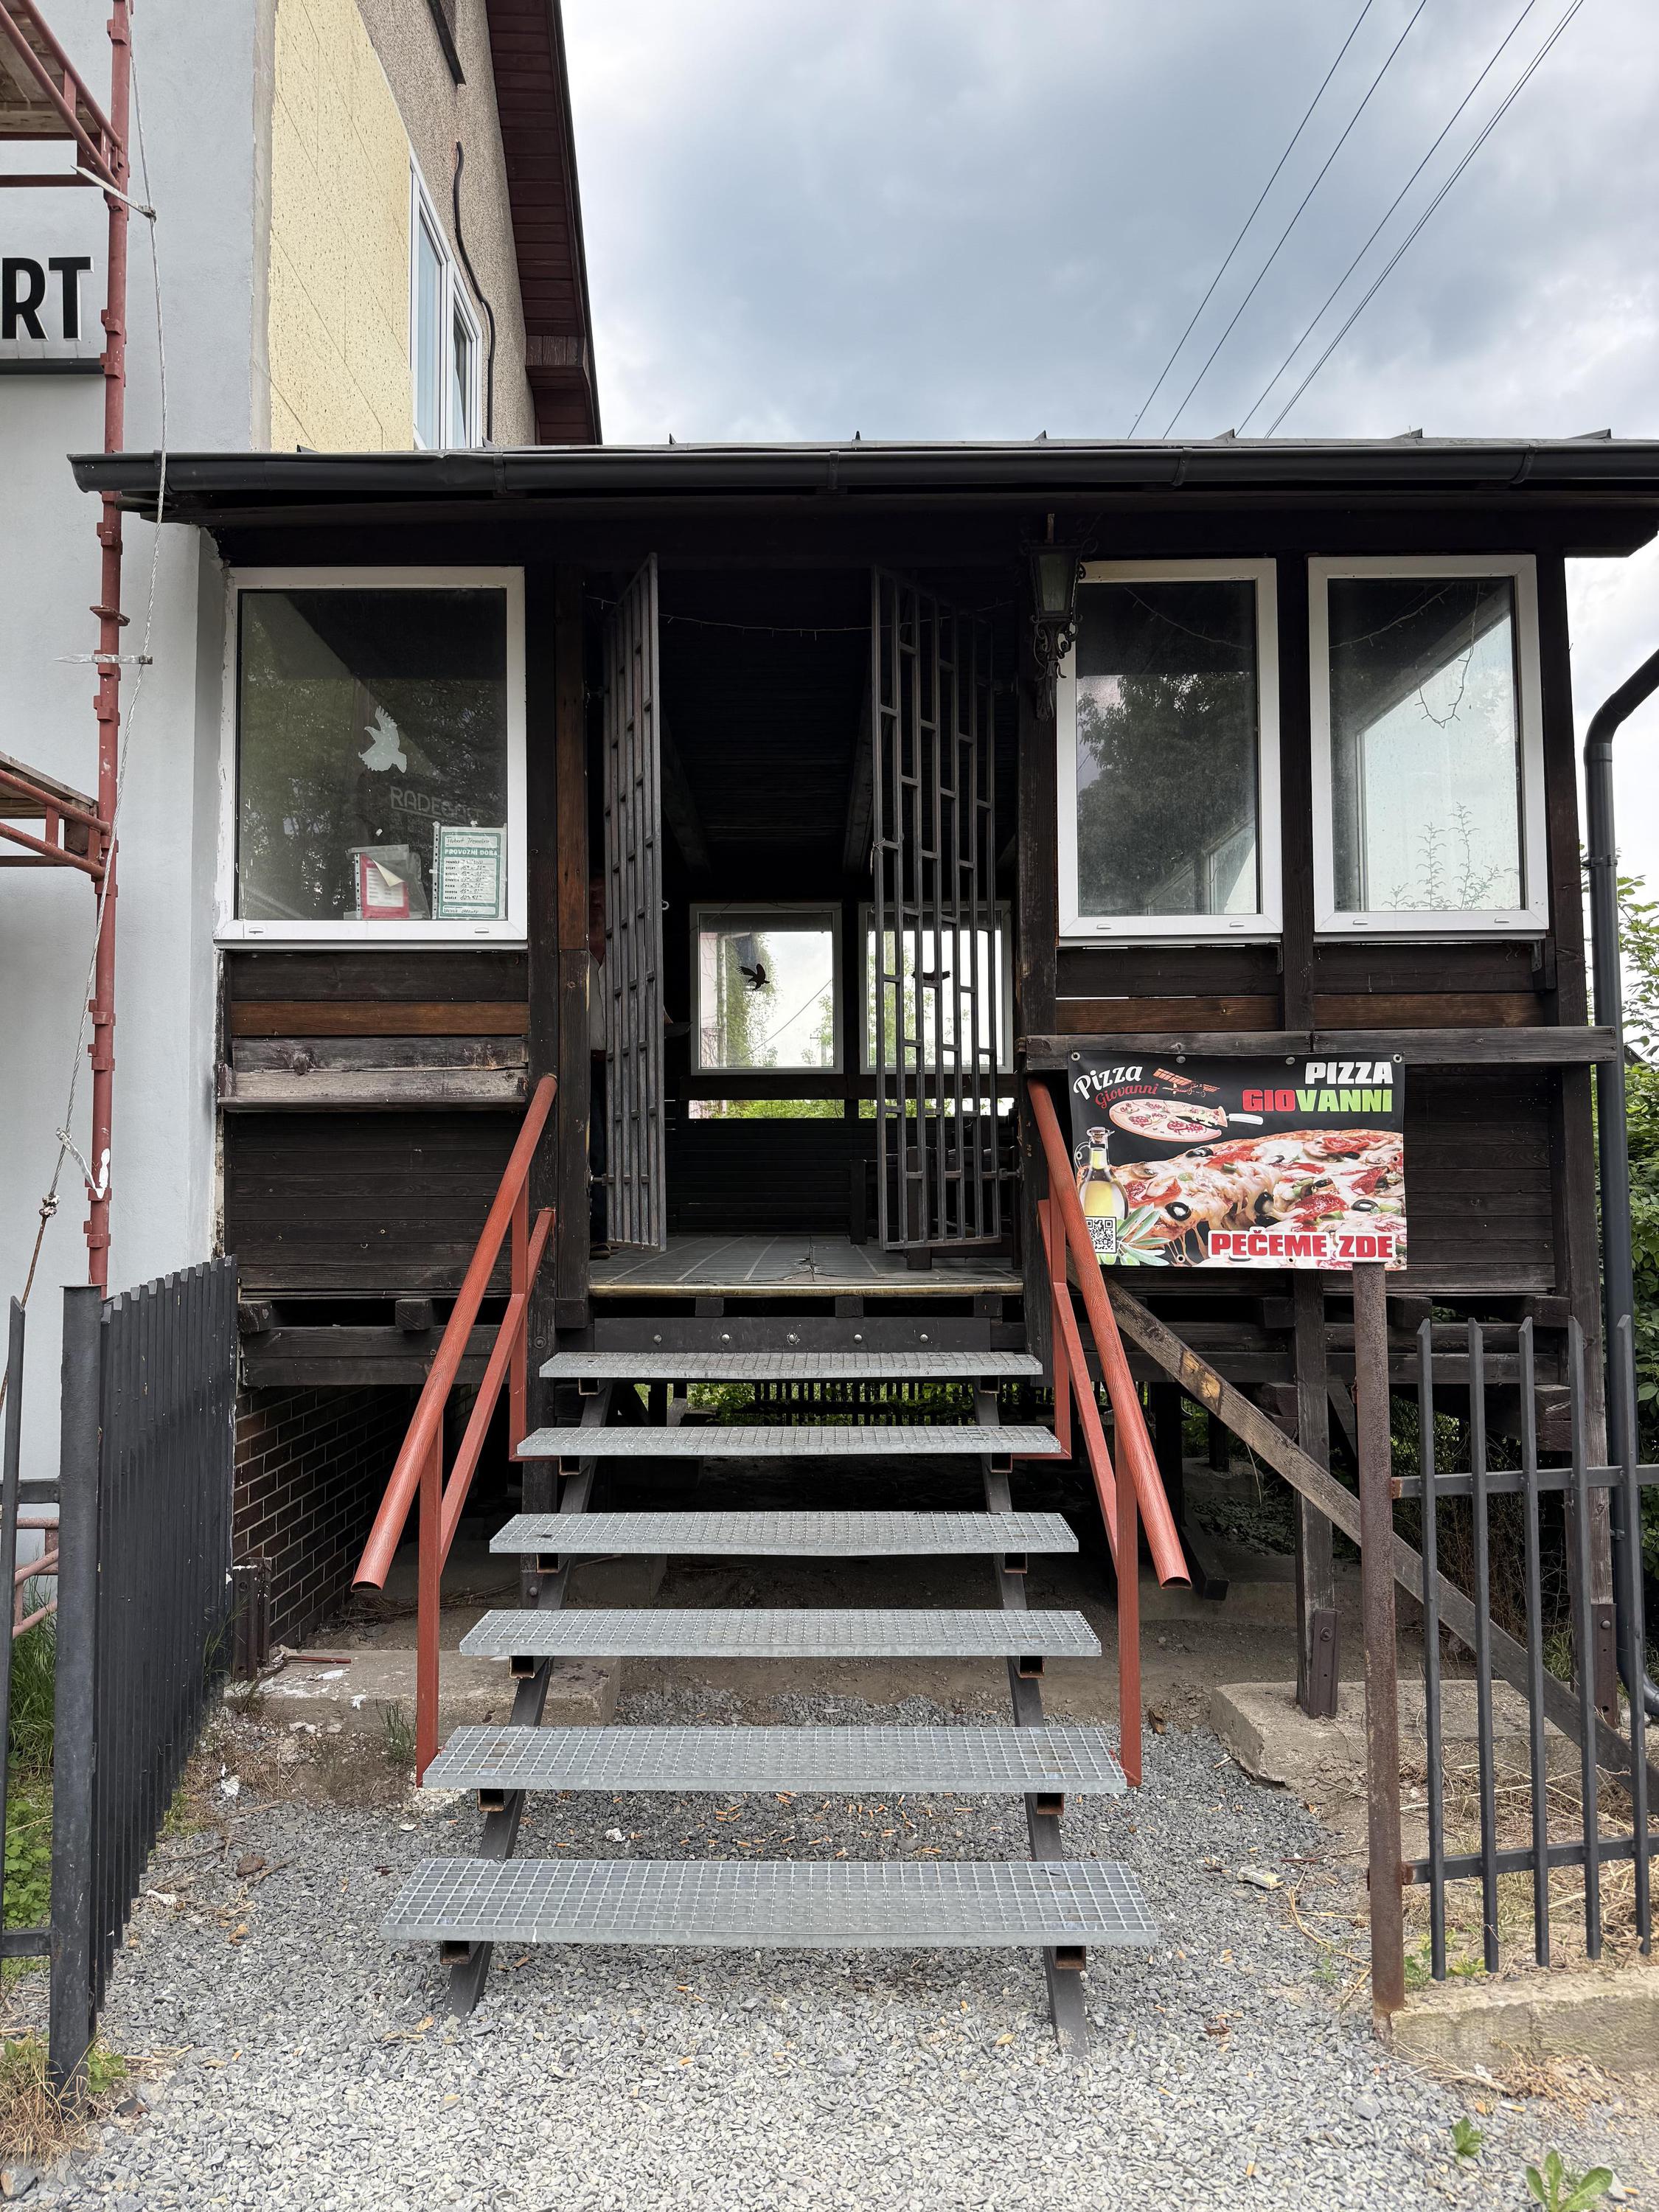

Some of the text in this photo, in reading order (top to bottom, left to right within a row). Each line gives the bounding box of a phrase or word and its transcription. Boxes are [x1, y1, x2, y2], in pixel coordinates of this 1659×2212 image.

[1, 256, 94, 341] RT
[1073, 1065, 1144, 1100] Pizza
[1304, 1061, 1394, 1085] PIZZA
[1094, 1082, 1160, 1109] Giovanni
[1242, 1088, 1393, 1112] GIOVANNI
[1211, 1229, 1393, 1258] PEČEME ZDE
